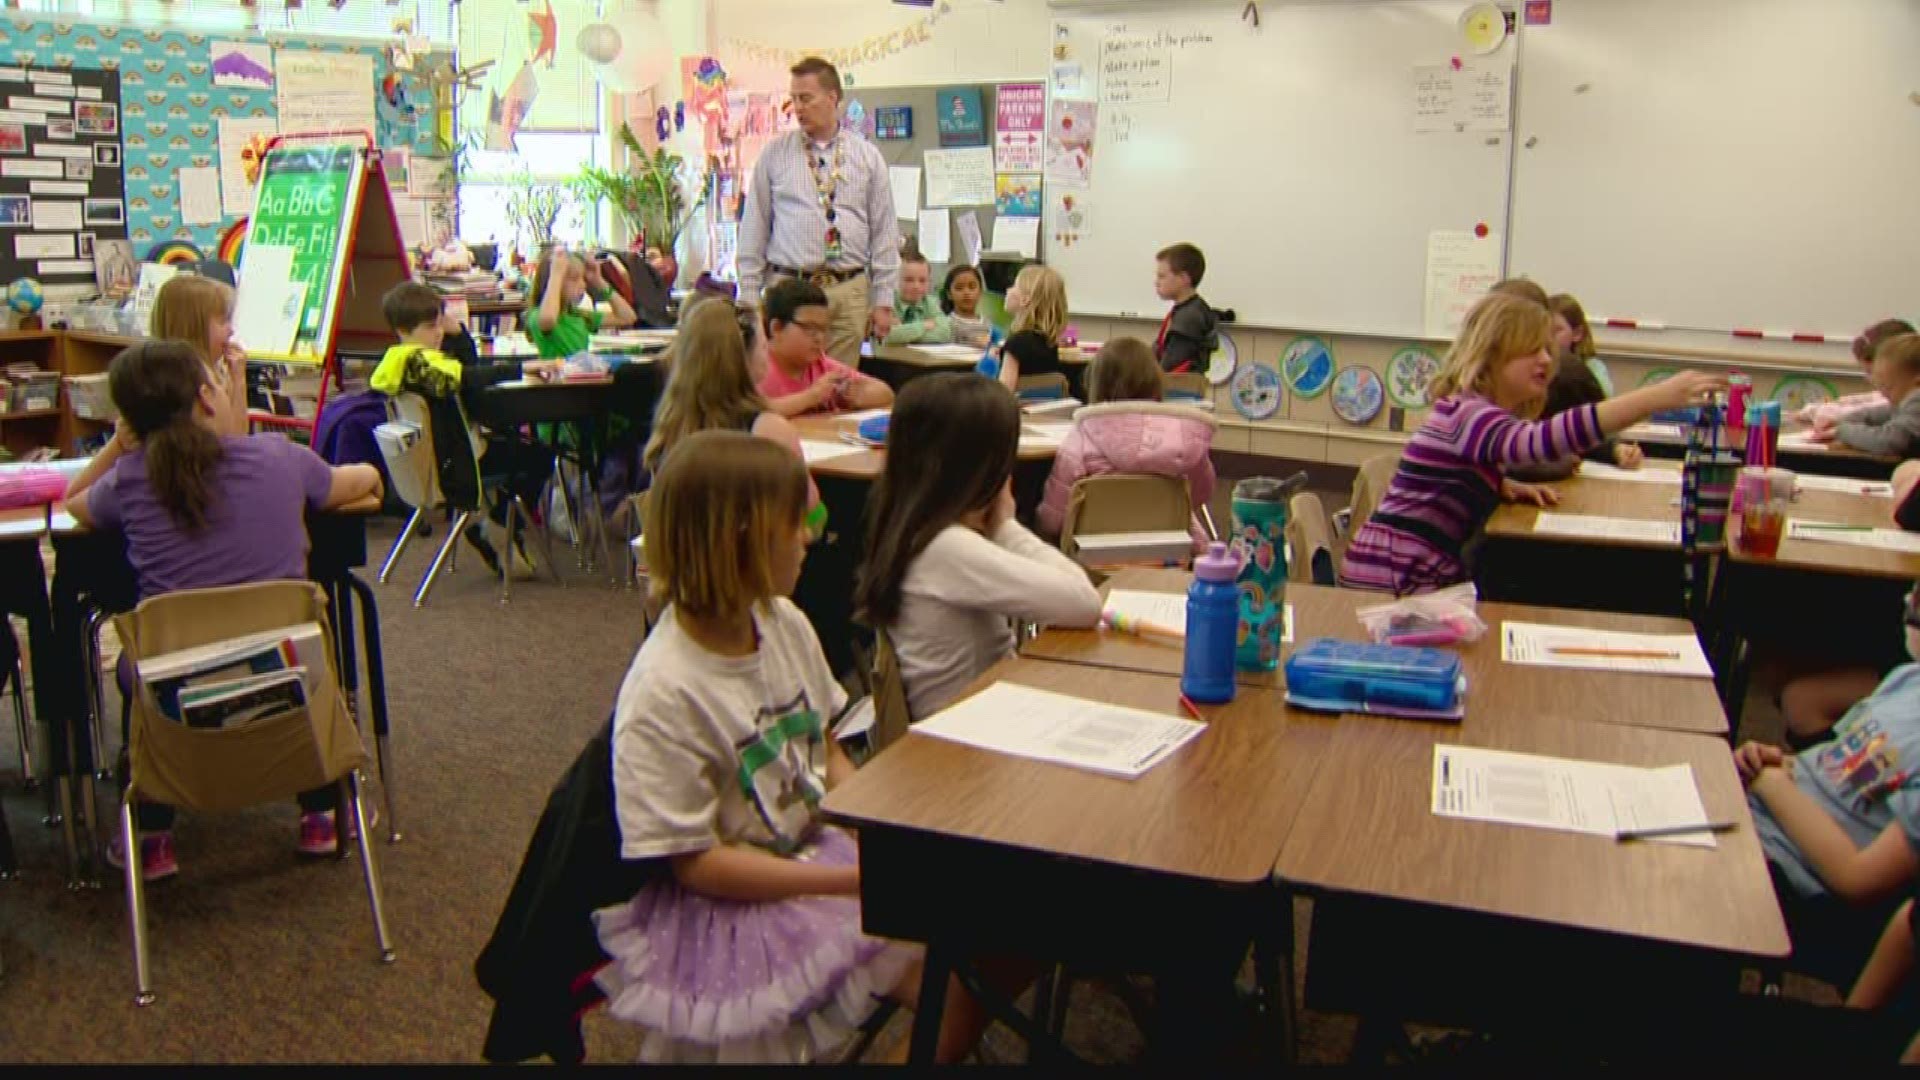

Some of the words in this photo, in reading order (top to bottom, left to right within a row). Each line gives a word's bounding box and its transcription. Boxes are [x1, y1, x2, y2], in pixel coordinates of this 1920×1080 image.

[1000, 88, 1042, 101] UNICORN
[1000, 102, 1042, 115] PARKING
[1007, 116, 1033, 129] ONLY
[259, 186, 285, 216] Aa
[287, 184, 314, 216] Bb
